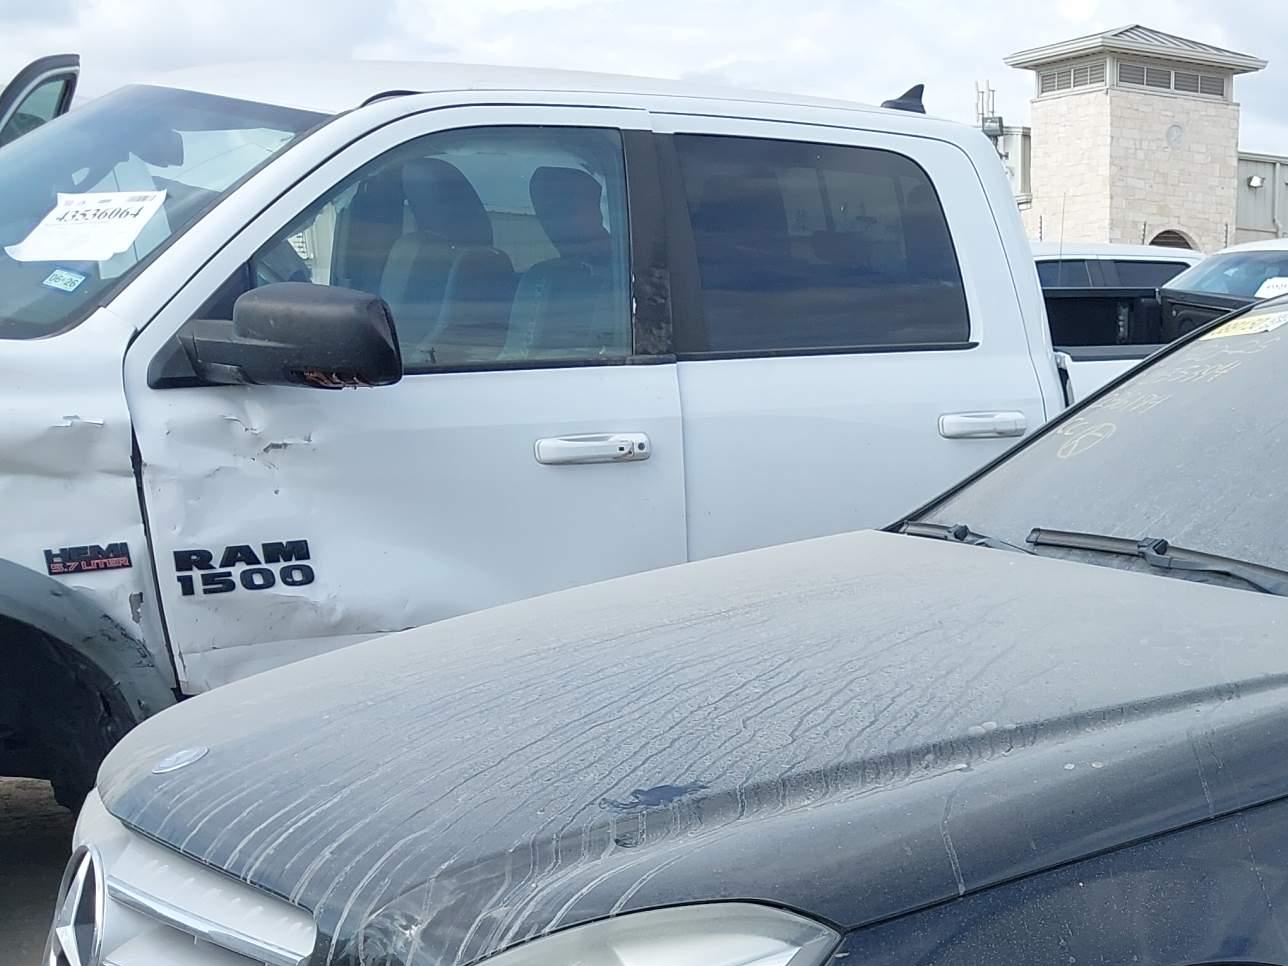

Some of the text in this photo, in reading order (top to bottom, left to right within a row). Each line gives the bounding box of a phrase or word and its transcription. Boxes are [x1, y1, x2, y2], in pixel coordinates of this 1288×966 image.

[56, 206, 144, 222] 43536064
[44, 542, 130, 563] HEMI
[173, 539, 311, 572] RAM
[50, 557, 130, 573] 5.7 LITER
[176, 563, 316, 596] 1500
